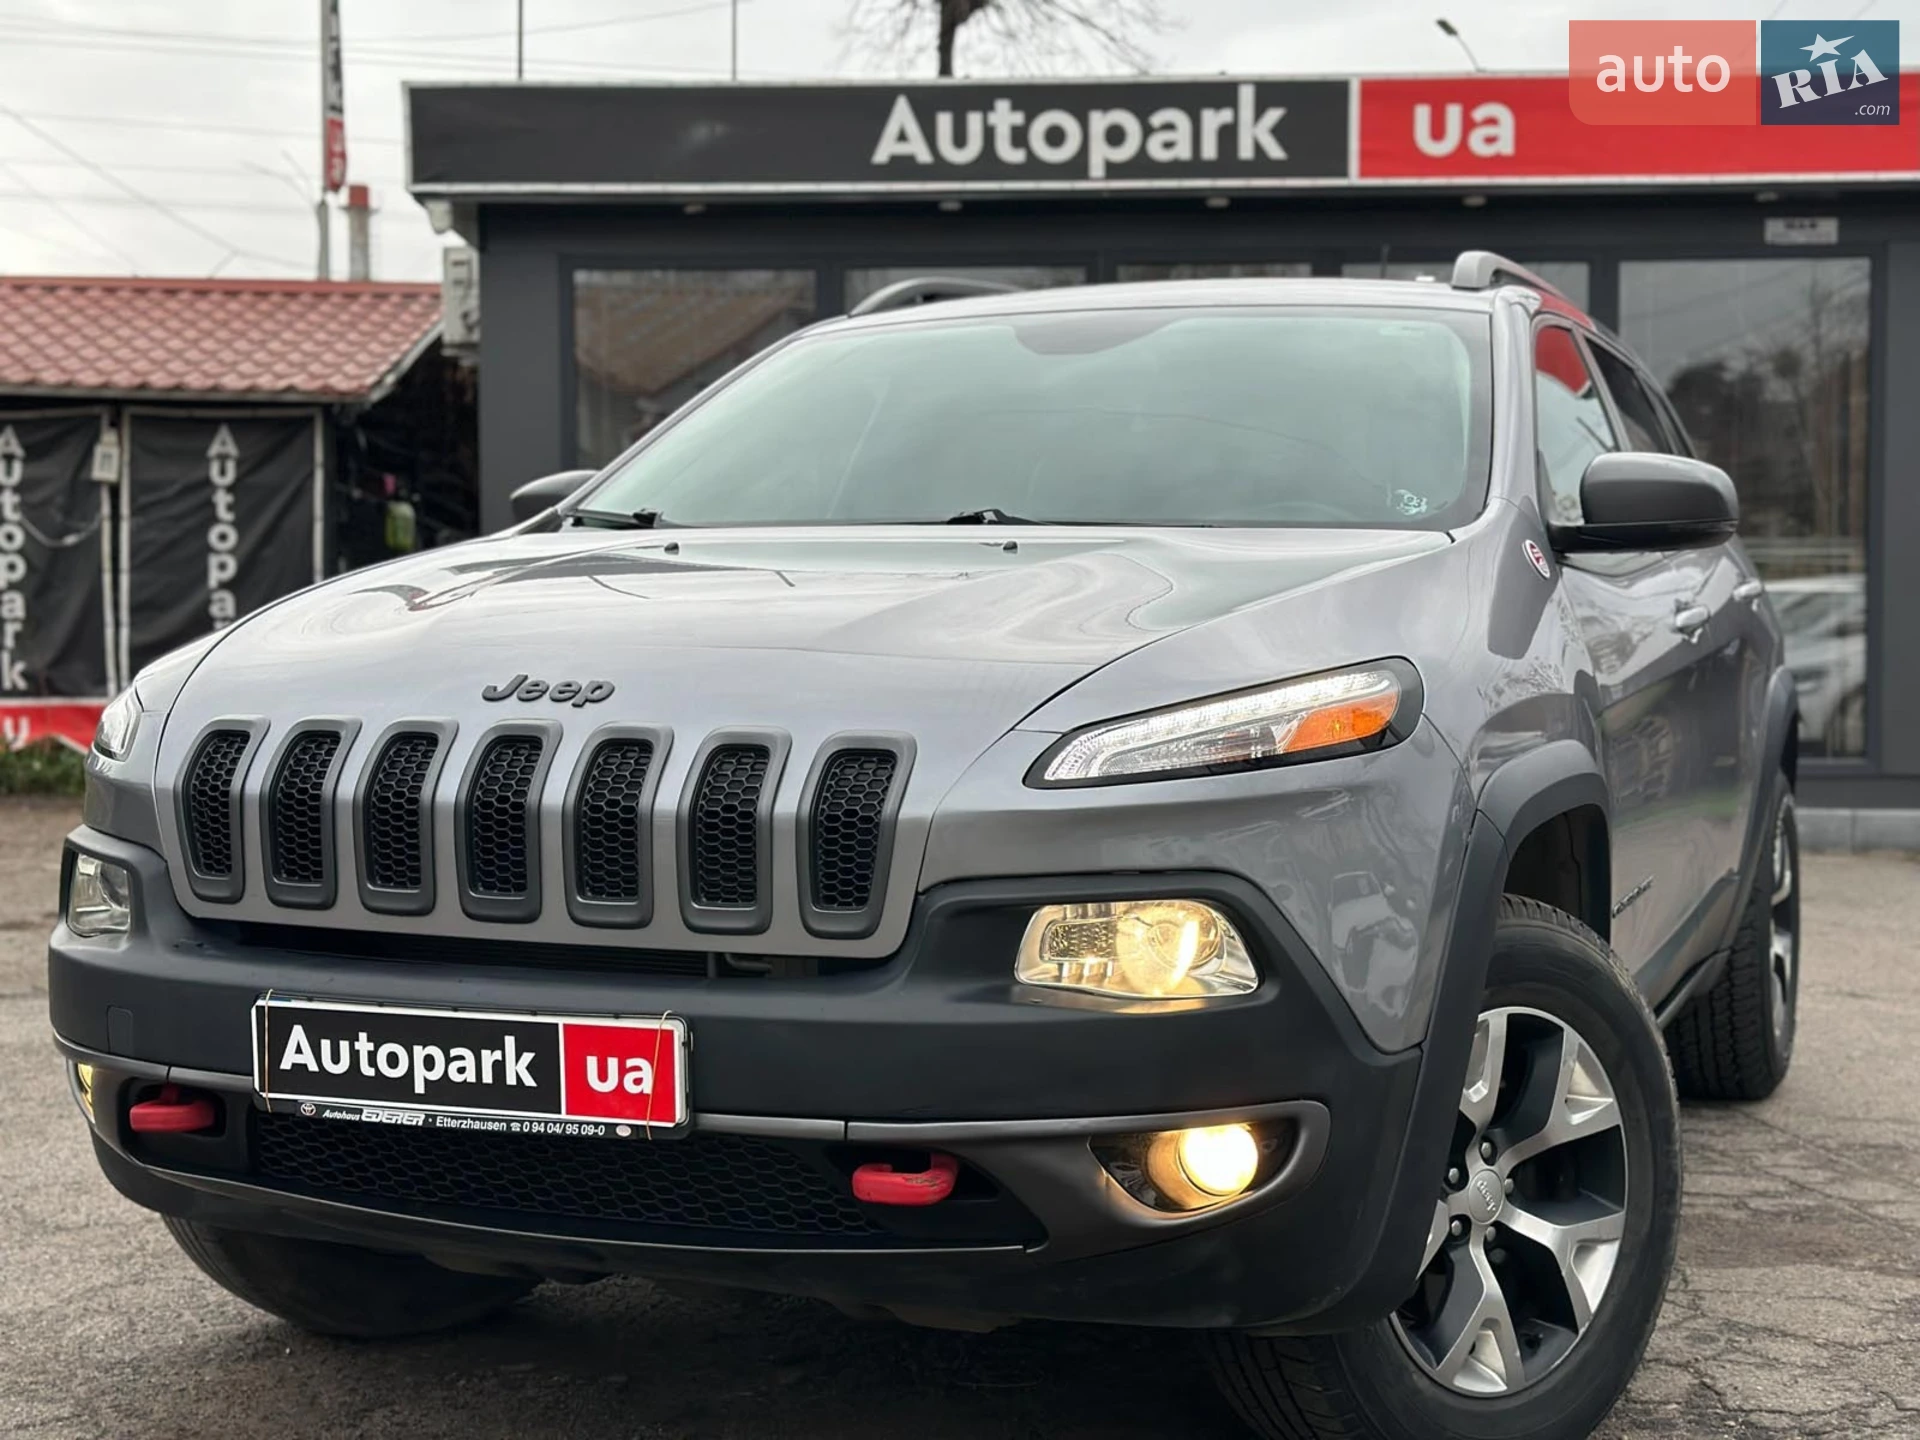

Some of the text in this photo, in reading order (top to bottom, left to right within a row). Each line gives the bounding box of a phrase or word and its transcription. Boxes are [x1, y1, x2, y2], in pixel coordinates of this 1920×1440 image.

[872, 84, 1515, 179] Autopark ua
[206, 423, 240, 630] Autopa
[481, 673, 616, 709] Jeep
[279, 1024, 654, 1095] Autopark ua
[322, 1109, 361, 1122] Autohaus
[435, 1116, 507, 1132] Etterzhausen
[580, 1124, 606, 1137] 09-0
